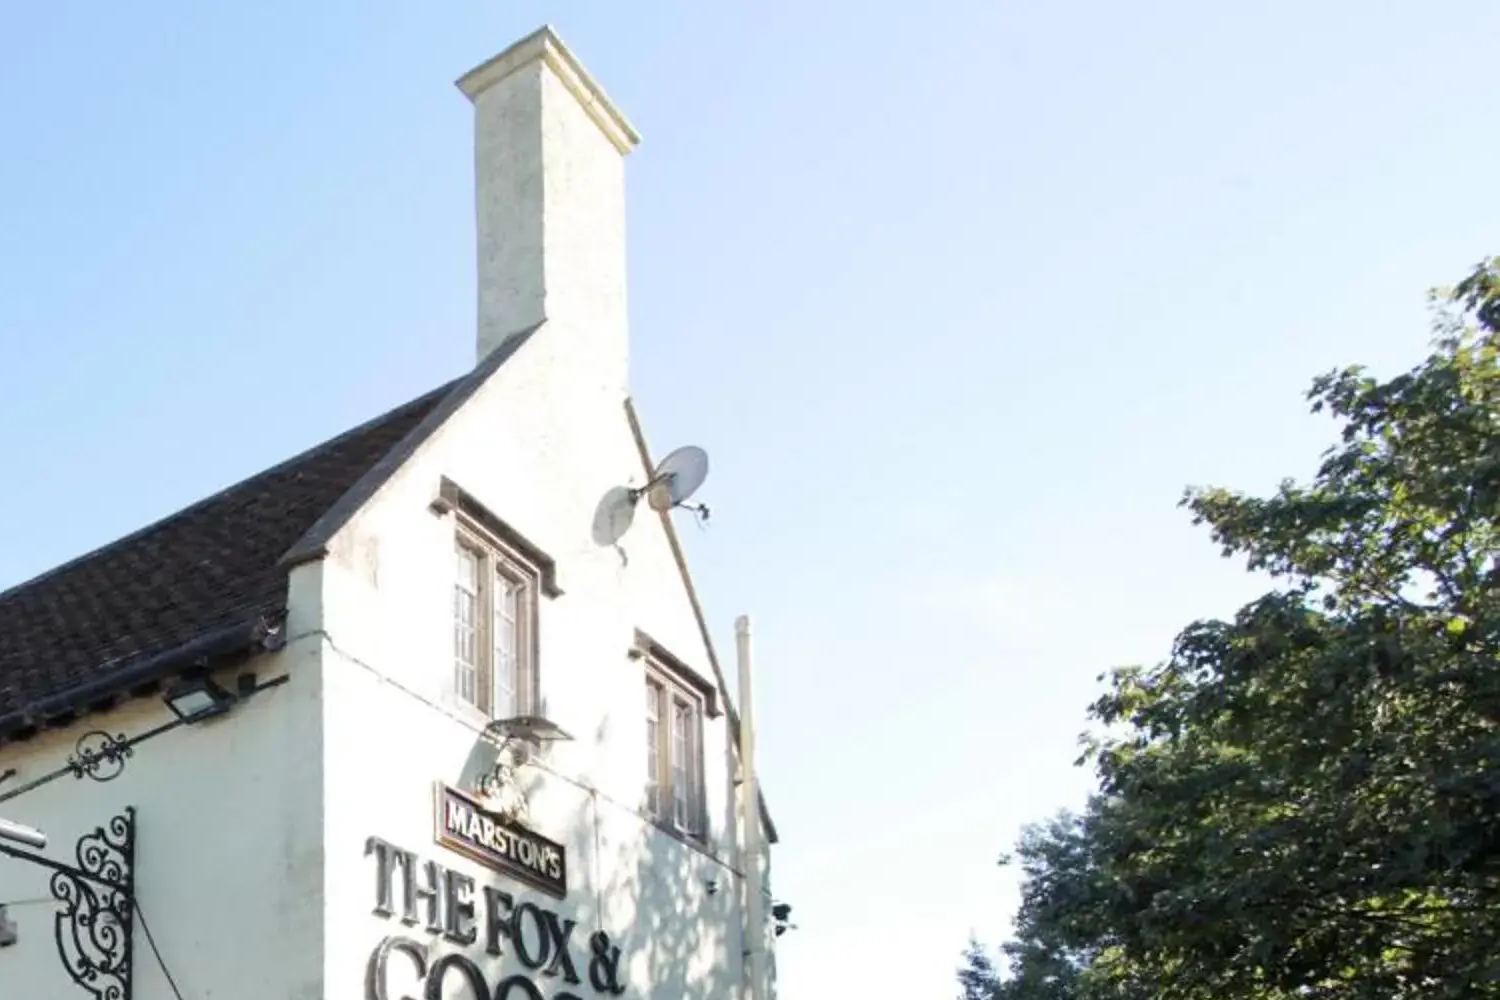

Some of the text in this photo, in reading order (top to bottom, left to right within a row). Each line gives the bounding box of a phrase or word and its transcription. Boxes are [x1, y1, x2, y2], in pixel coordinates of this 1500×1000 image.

[445, 803, 560, 881] MARSTON'S
[364, 835, 625, 996] THE FOX &
